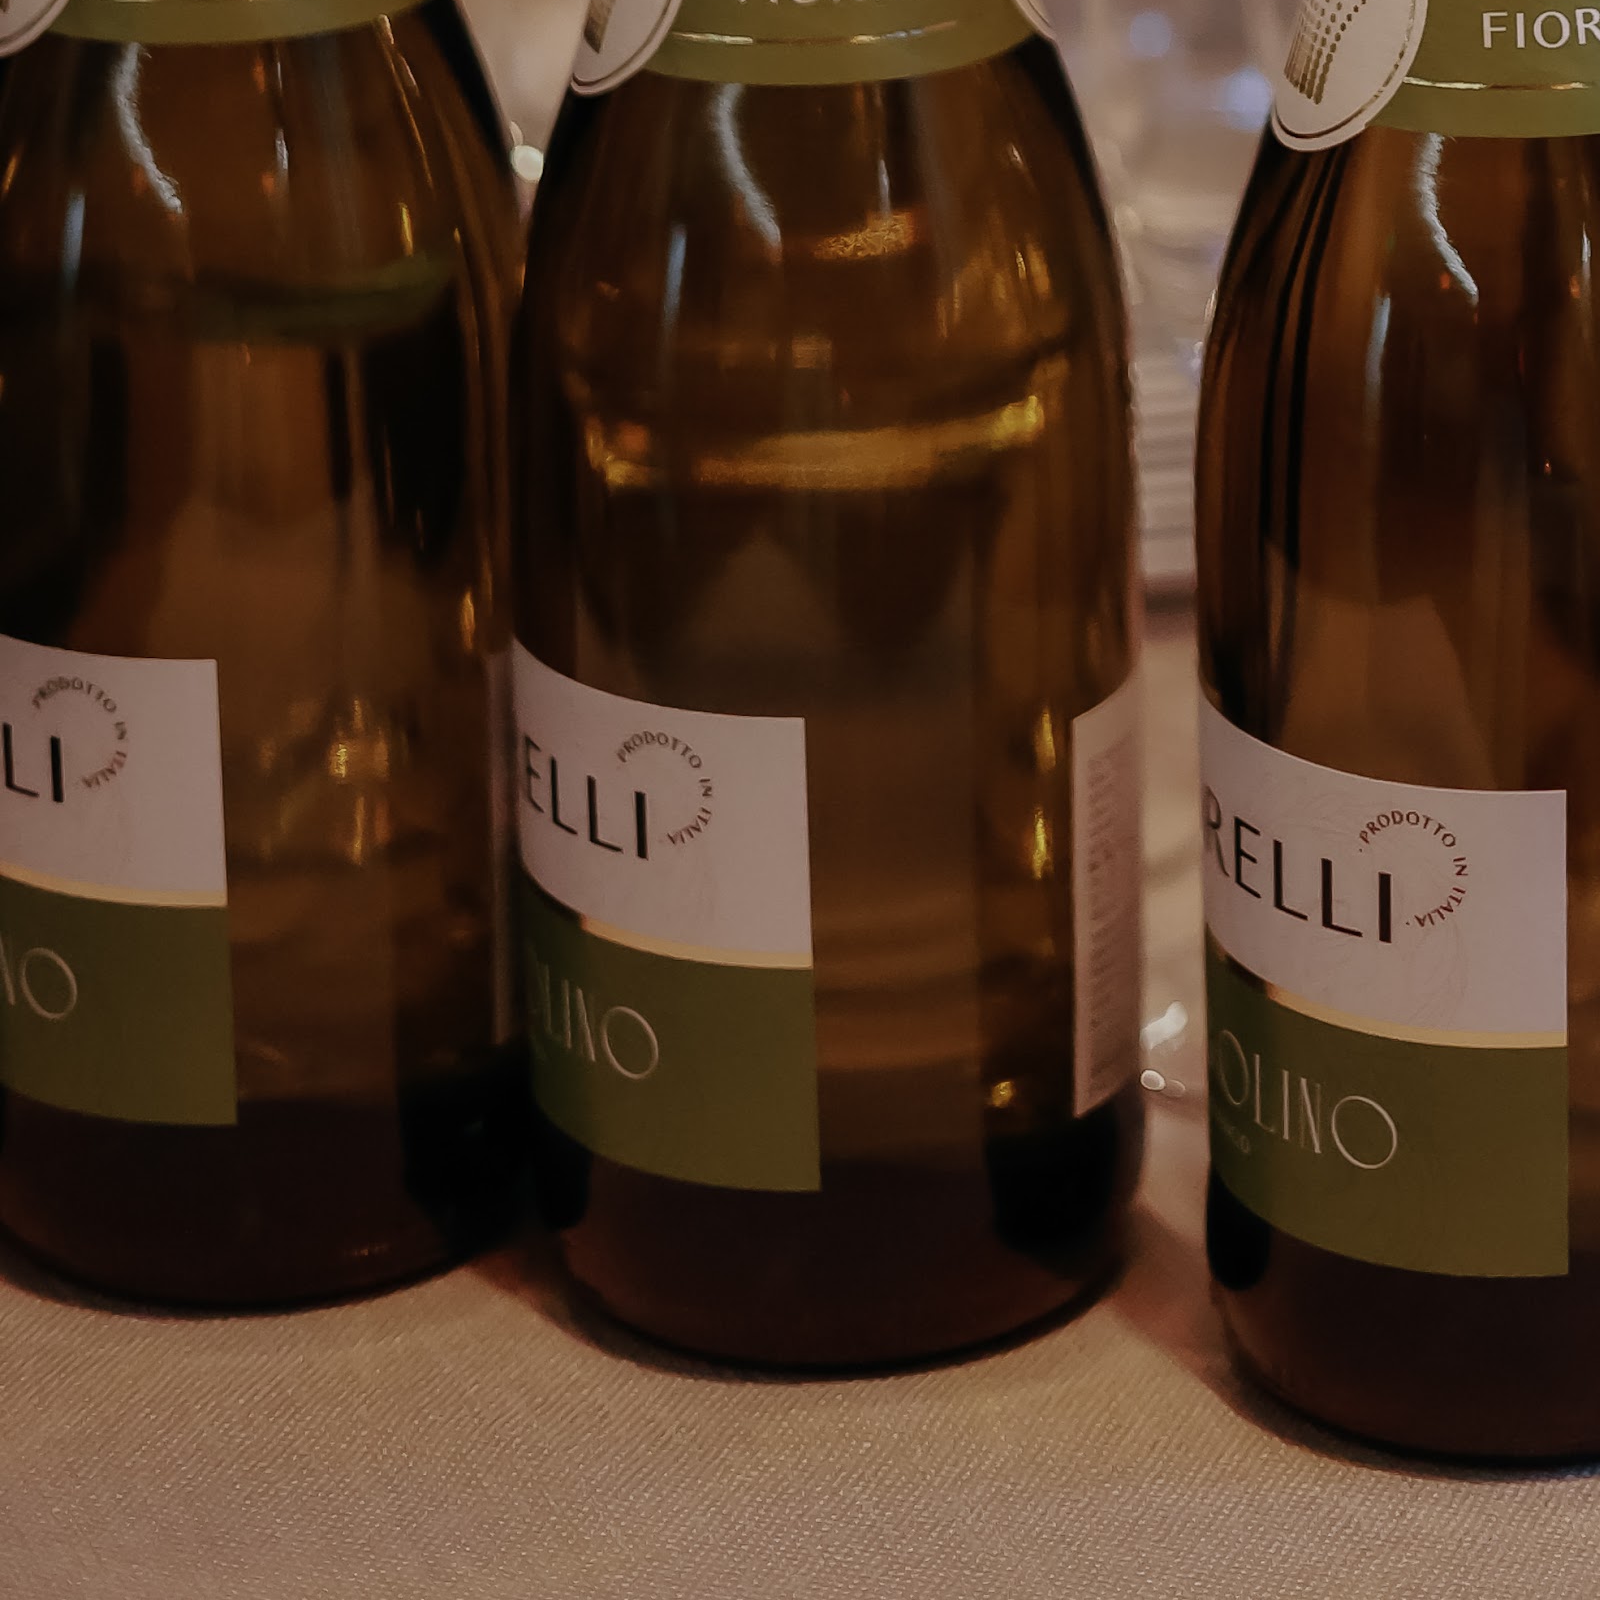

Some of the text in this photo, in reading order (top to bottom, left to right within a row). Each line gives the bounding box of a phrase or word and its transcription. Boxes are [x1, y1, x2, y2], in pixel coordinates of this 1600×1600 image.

[617, 730, 713, 844] PRODOTTO IN ITALIA
[1359, 810, 1469, 928] PRODOTTO IN ITALIA
